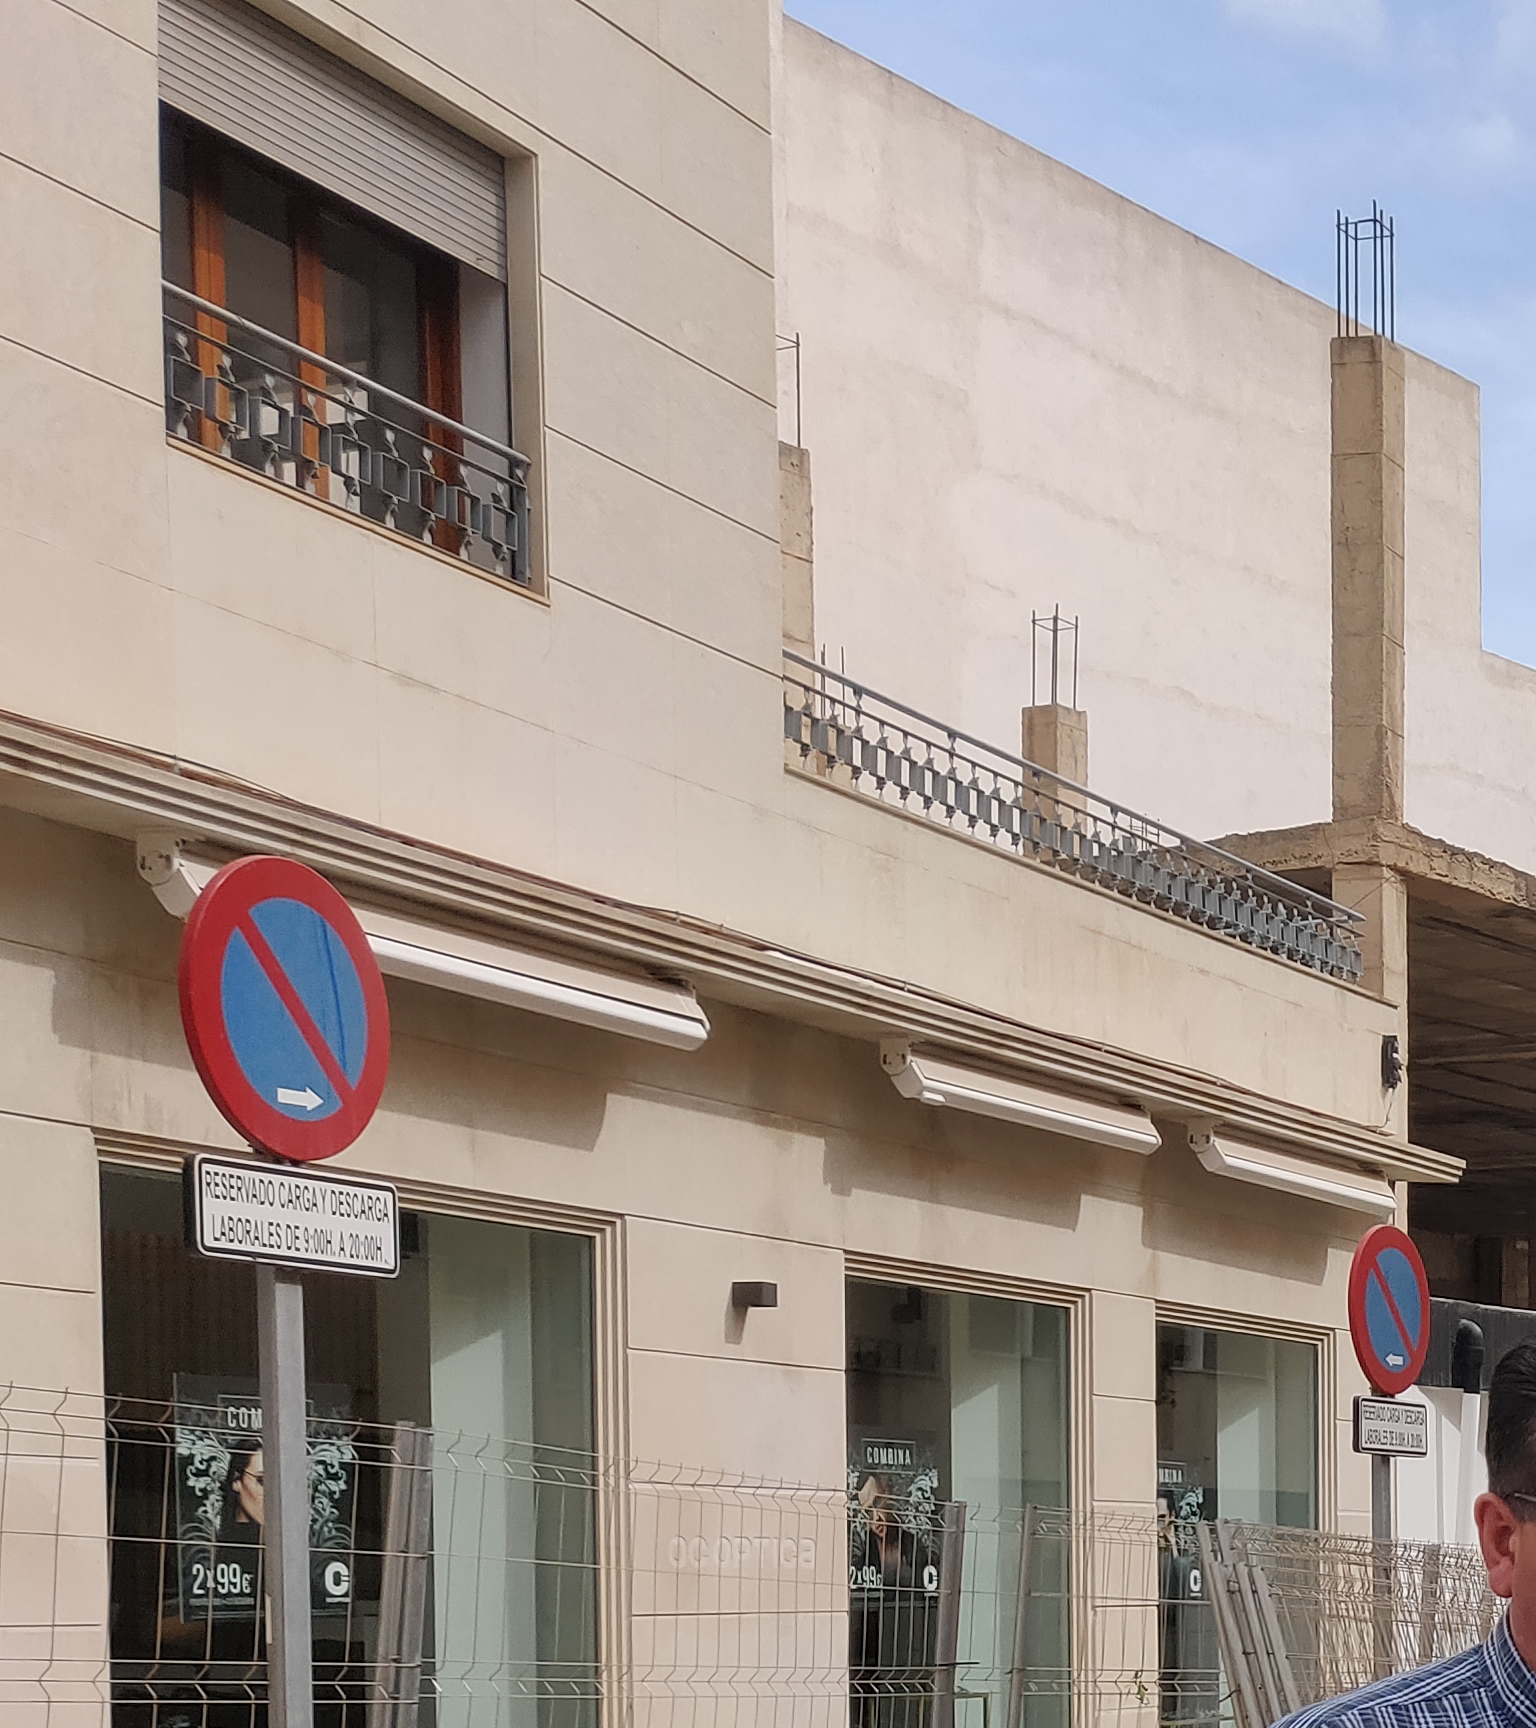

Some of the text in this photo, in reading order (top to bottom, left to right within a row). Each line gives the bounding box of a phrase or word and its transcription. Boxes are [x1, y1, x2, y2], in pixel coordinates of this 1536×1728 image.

[204, 1170, 390, 1224] RESERVADO CARGA Y DESCARGA
[212, 1213, 282, 1250] LABORALES
[286, 1223, 300, 1250] DE
[338, 1230, 346, 1257] A
[226, 1406, 262, 1430] COM
